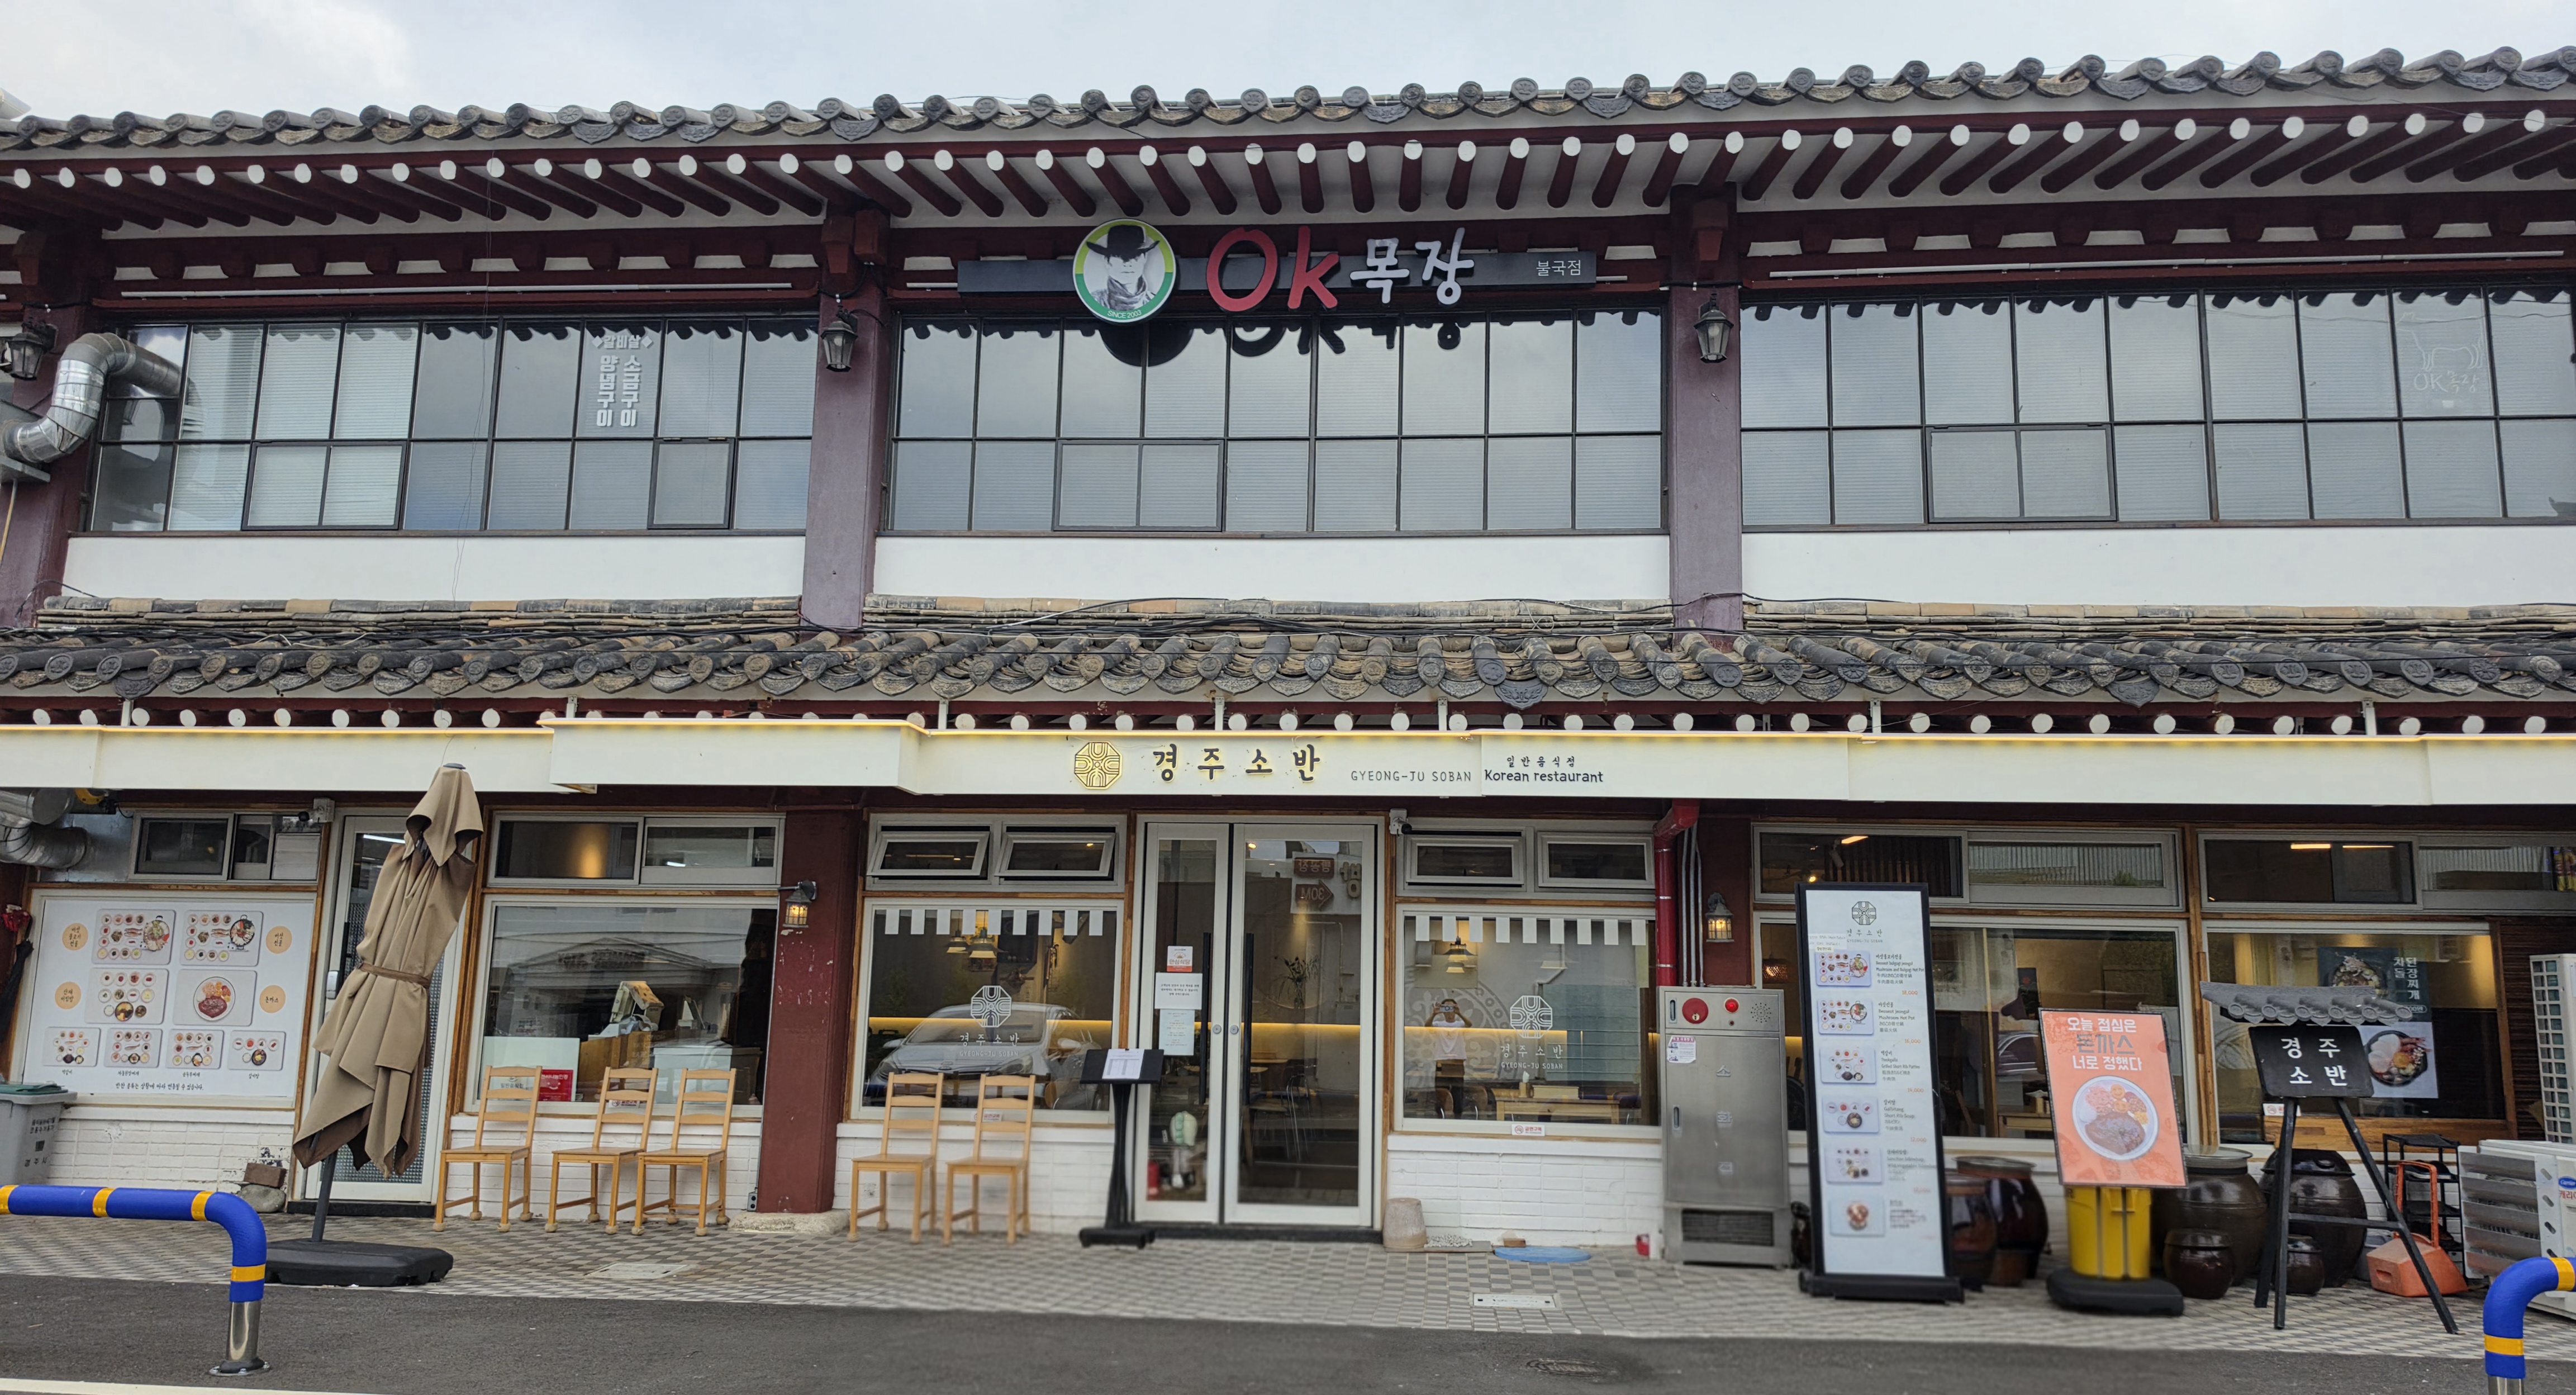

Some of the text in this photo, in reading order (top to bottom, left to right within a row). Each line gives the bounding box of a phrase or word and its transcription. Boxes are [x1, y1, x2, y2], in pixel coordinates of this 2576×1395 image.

[1535, 258, 1582, 277] 불국점
[1127, 310, 1142, 318] 2003
[603, 335, 641, 349] 갈비살
[596, 355, 619, 426] 양념구이
[620, 355, 641, 426] 소금구이
[1153, 744, 1320, 781] 경주소반
[1507, 756, 1575, 767] 일반음식점
[1351, 770, 1471, 781] GYEONG-JU SOBAN
[1485, 770, 1603, 782] Korean restaurant
[2394, 957, 2405, 978] 차돌
[2406, 957, 2420, 999] 된장찌개
[2068, 1017, 2137, 1033] 오늘 점심은
[961, 1032, 1020, 1046] 경주소반
[1500, 1043, 1563, 1059] 경주소반
[2281, 1037, 2341, 1059] 경주
[2073, 1055, 2142, 1071] 너로 정했다
[2289, 1065, 2347, 1086] 소반
